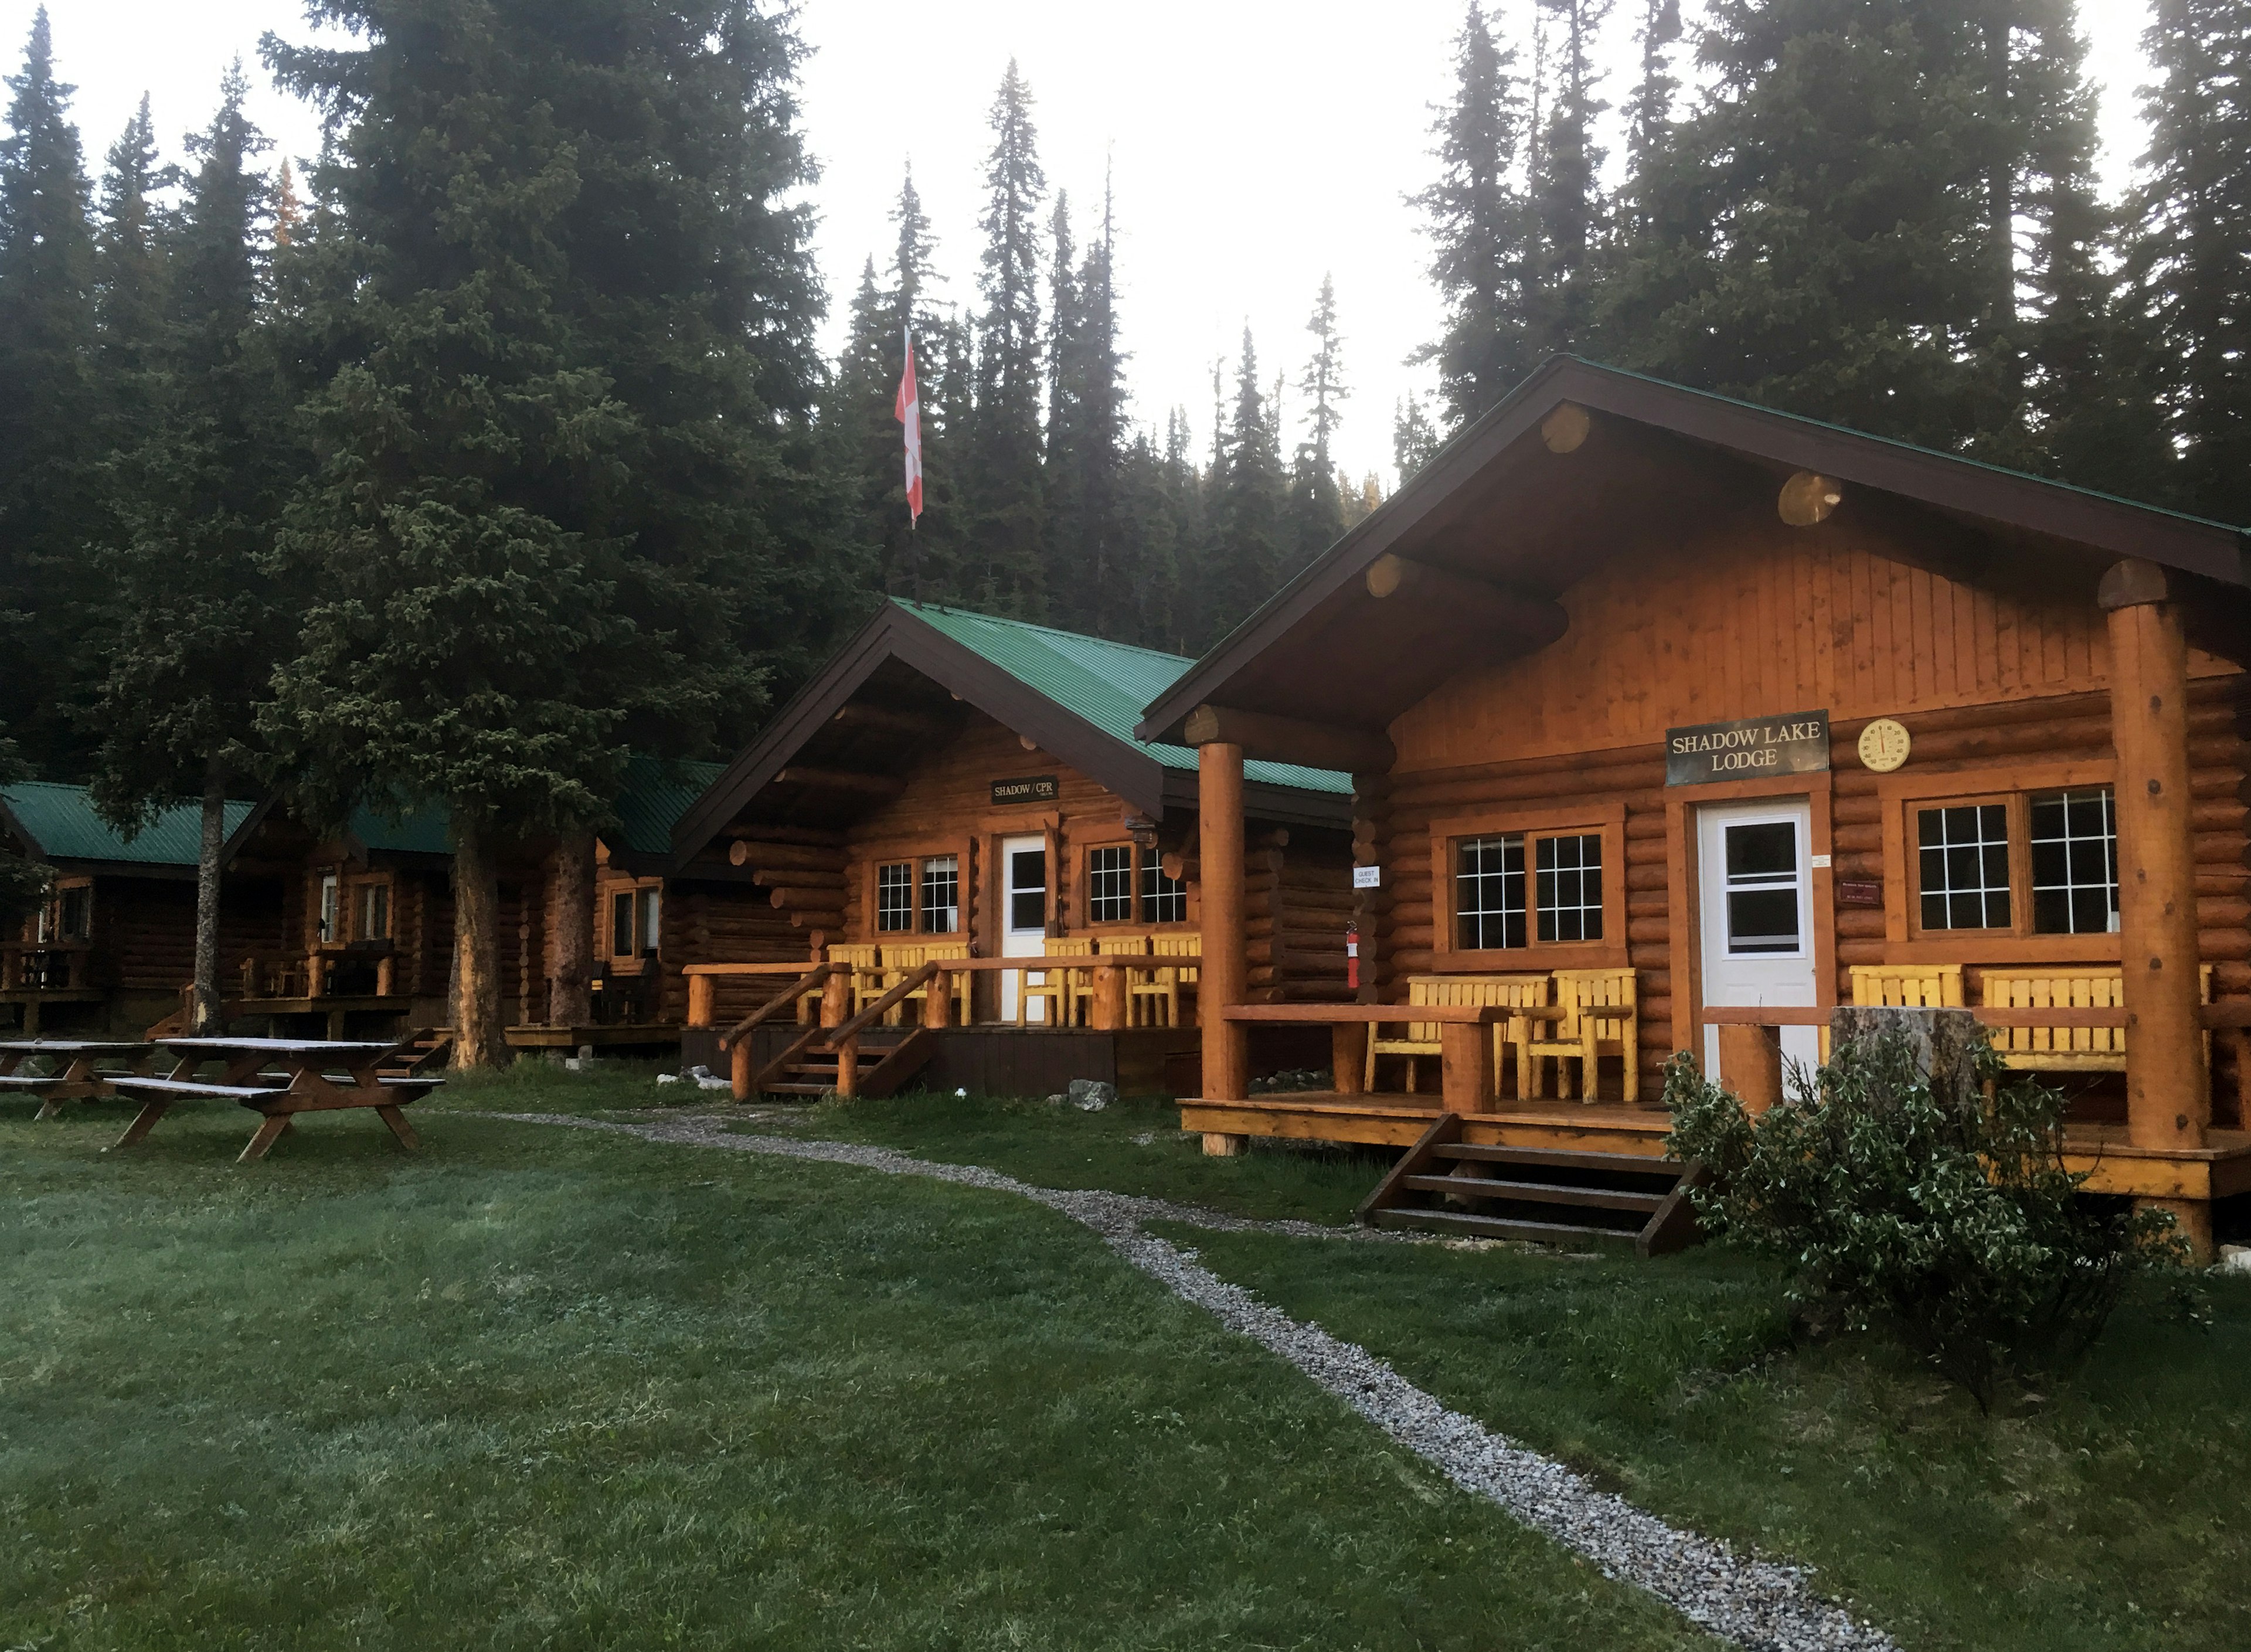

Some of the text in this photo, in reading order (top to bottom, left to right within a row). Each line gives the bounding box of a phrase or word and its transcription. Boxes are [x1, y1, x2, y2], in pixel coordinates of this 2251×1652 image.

[1672, 721, 1821, 754] SHADOW LAKE
[1712, 749, 1777, 771] LODGE
